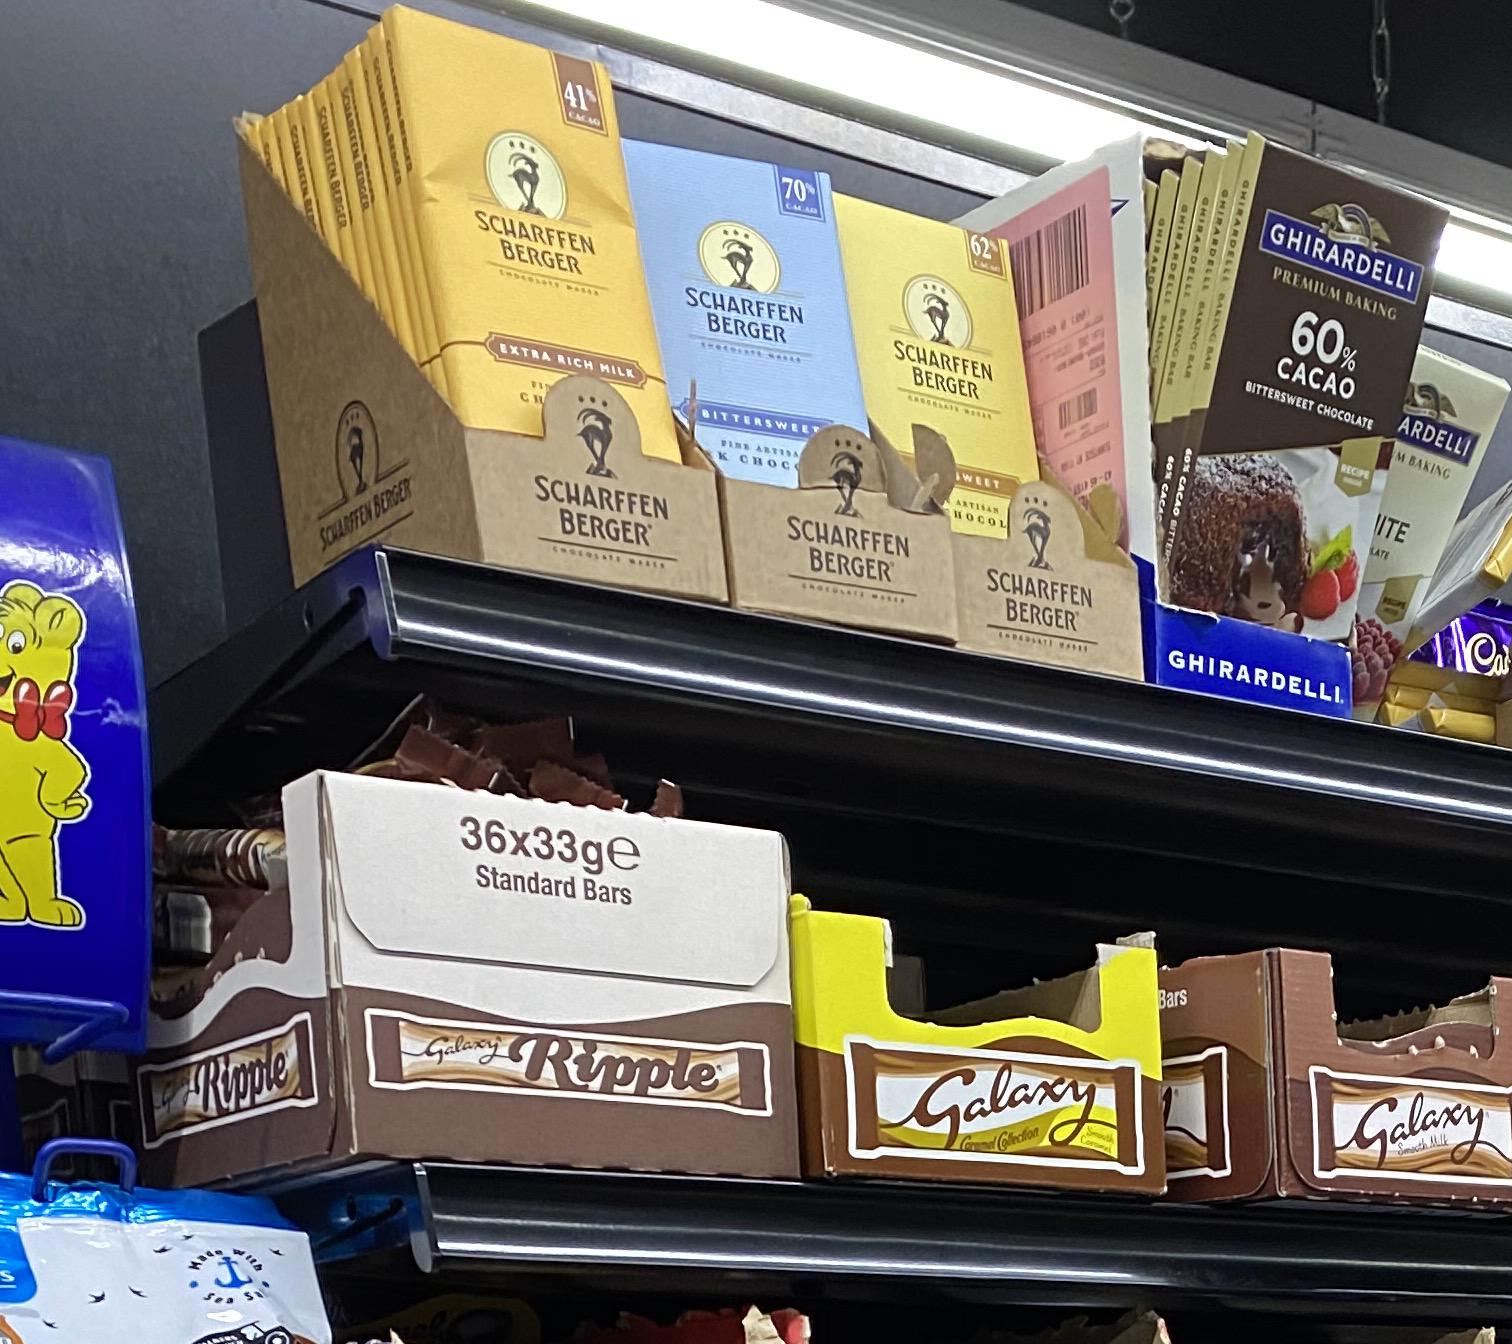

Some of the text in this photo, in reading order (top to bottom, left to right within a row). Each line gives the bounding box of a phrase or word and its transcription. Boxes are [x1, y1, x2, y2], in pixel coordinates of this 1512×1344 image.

[477, 211, 595, 256] SCHARFFEN
[500, 241, 582, 276] BERGER
[1269, 223, 1418, 293] GHIRARDELLI
[1272, 266, 1398, 320] PREMIUM BAKING
[706, 313, 787, 344] BERGER
[1291, 311, 1358, 371] 60%
[499, 343, 636, 380] EXTRA RICH MILK
[912, 367, 980, 400] BERGER
[1276, 357, 1356, 399] CACAO
[1245, 380, 1374, 431] BITTERSWEET CHOCOLATE
[319, 477, 412, 551] SCHARFFEN BERGER
[534, 474, 669, 520] SCHARFFEN
[787, 515, 911, 559] SCHARFFEN
[986, 568, 1094, 608] SCHARFFEN
[1169, 649, 1344, 705] GHIRARDELLI
[475, 864, 633, 906] Standard Bars
[196, 1043, 290, 1105] Ripple
